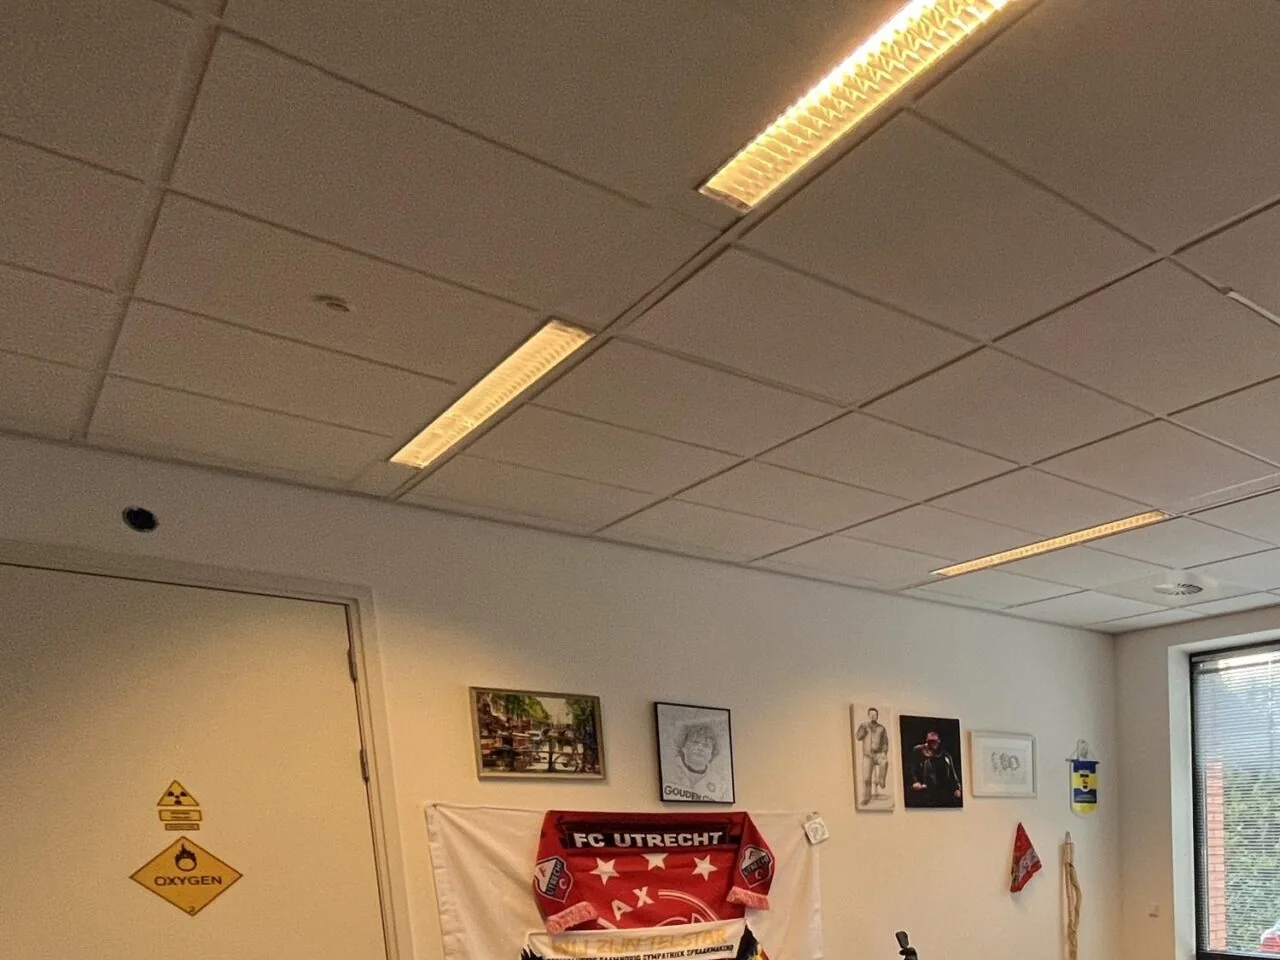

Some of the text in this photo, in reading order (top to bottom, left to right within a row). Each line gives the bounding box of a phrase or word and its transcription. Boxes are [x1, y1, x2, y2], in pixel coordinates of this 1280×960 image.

[573, 831, 723, 848] FC UTRECHT
[154, 875, 222, 886] OXYGEN
